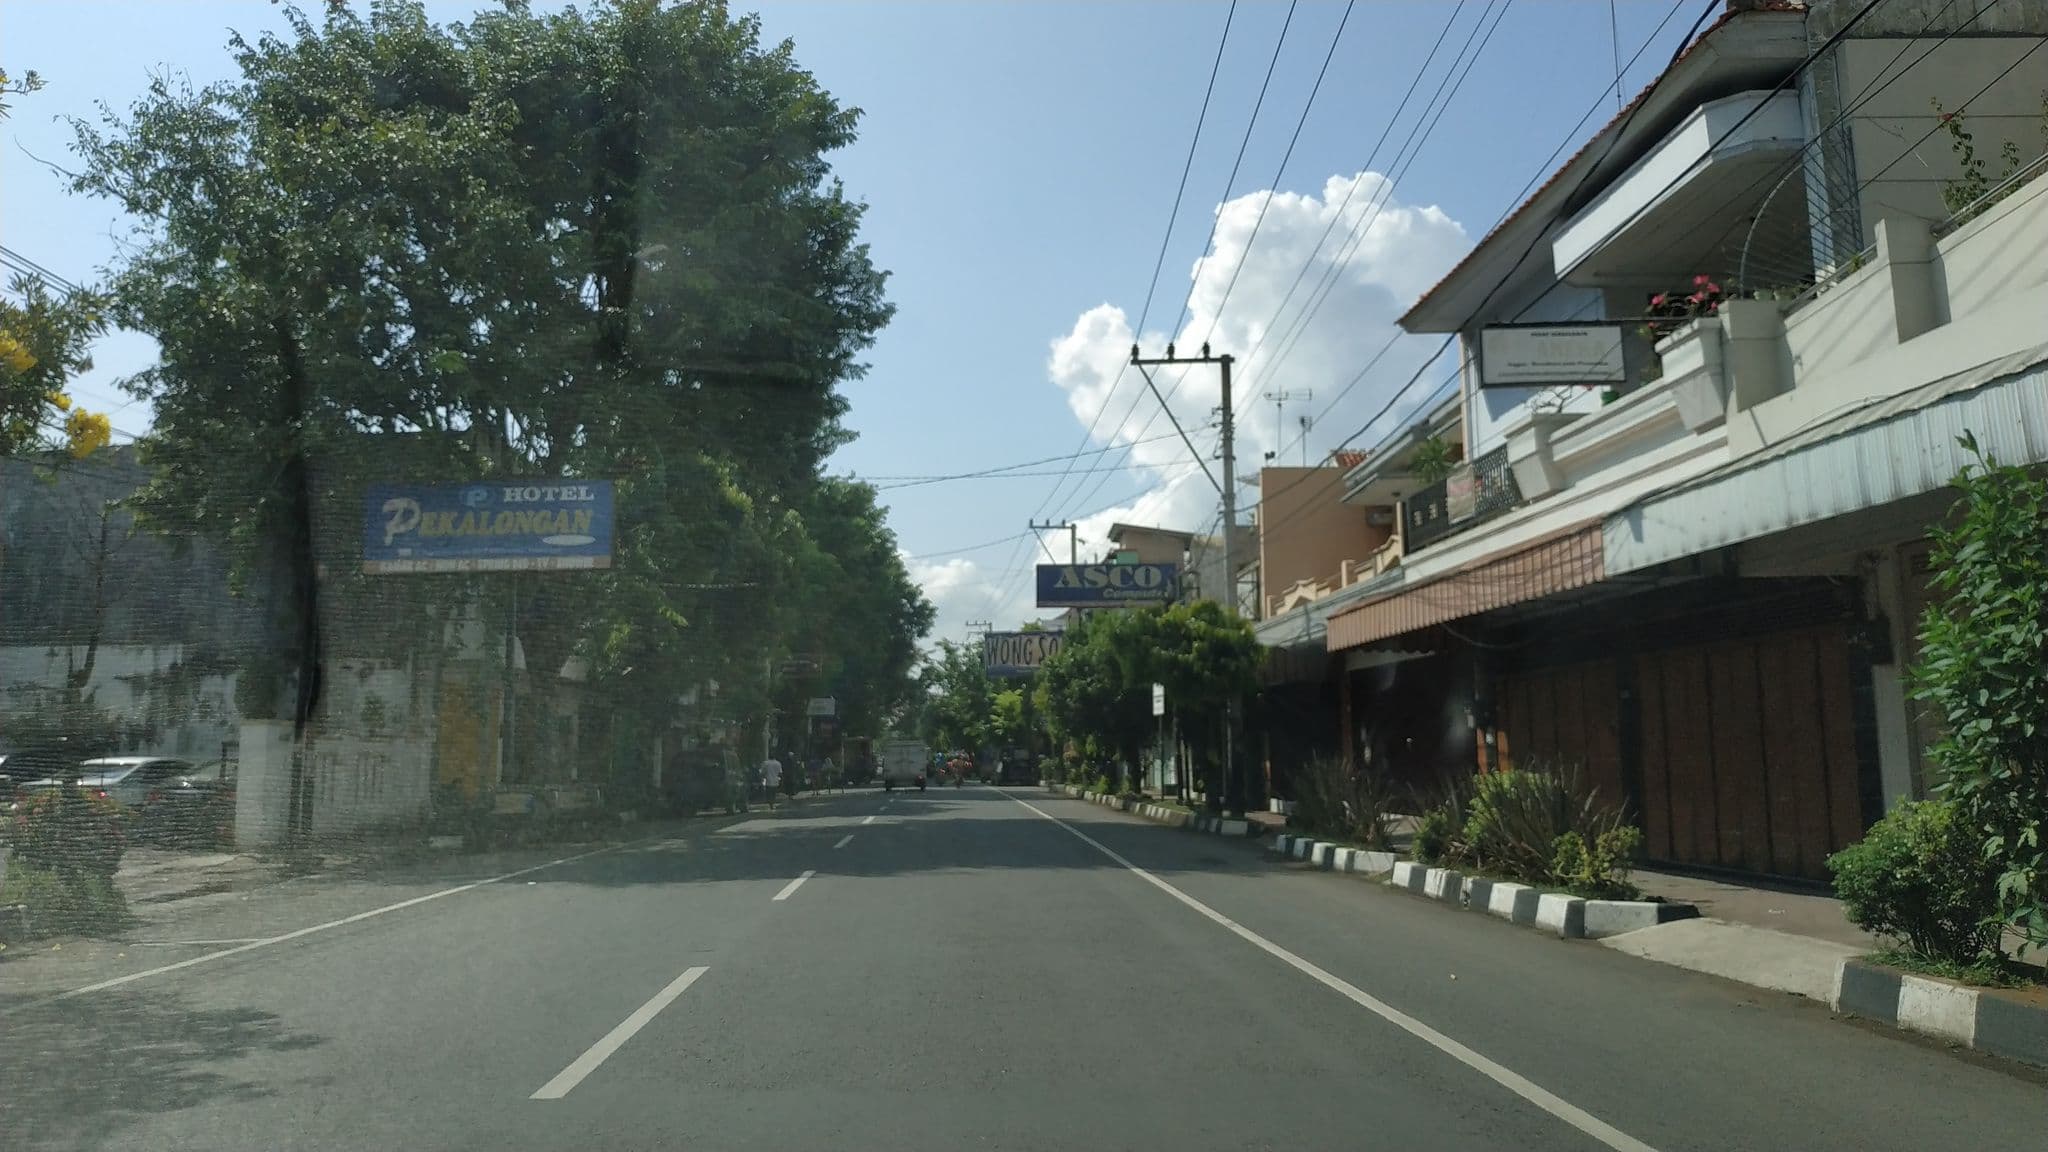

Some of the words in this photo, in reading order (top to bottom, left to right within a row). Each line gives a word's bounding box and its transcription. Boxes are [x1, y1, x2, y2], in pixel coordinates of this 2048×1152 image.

[503, 486, 595, 502] HOTEL
[382, 496, 593, 546] PEKALONGAN
[1053, 566, 1162, 589] ASCO
[988, 635, 1034, 666] WONG
